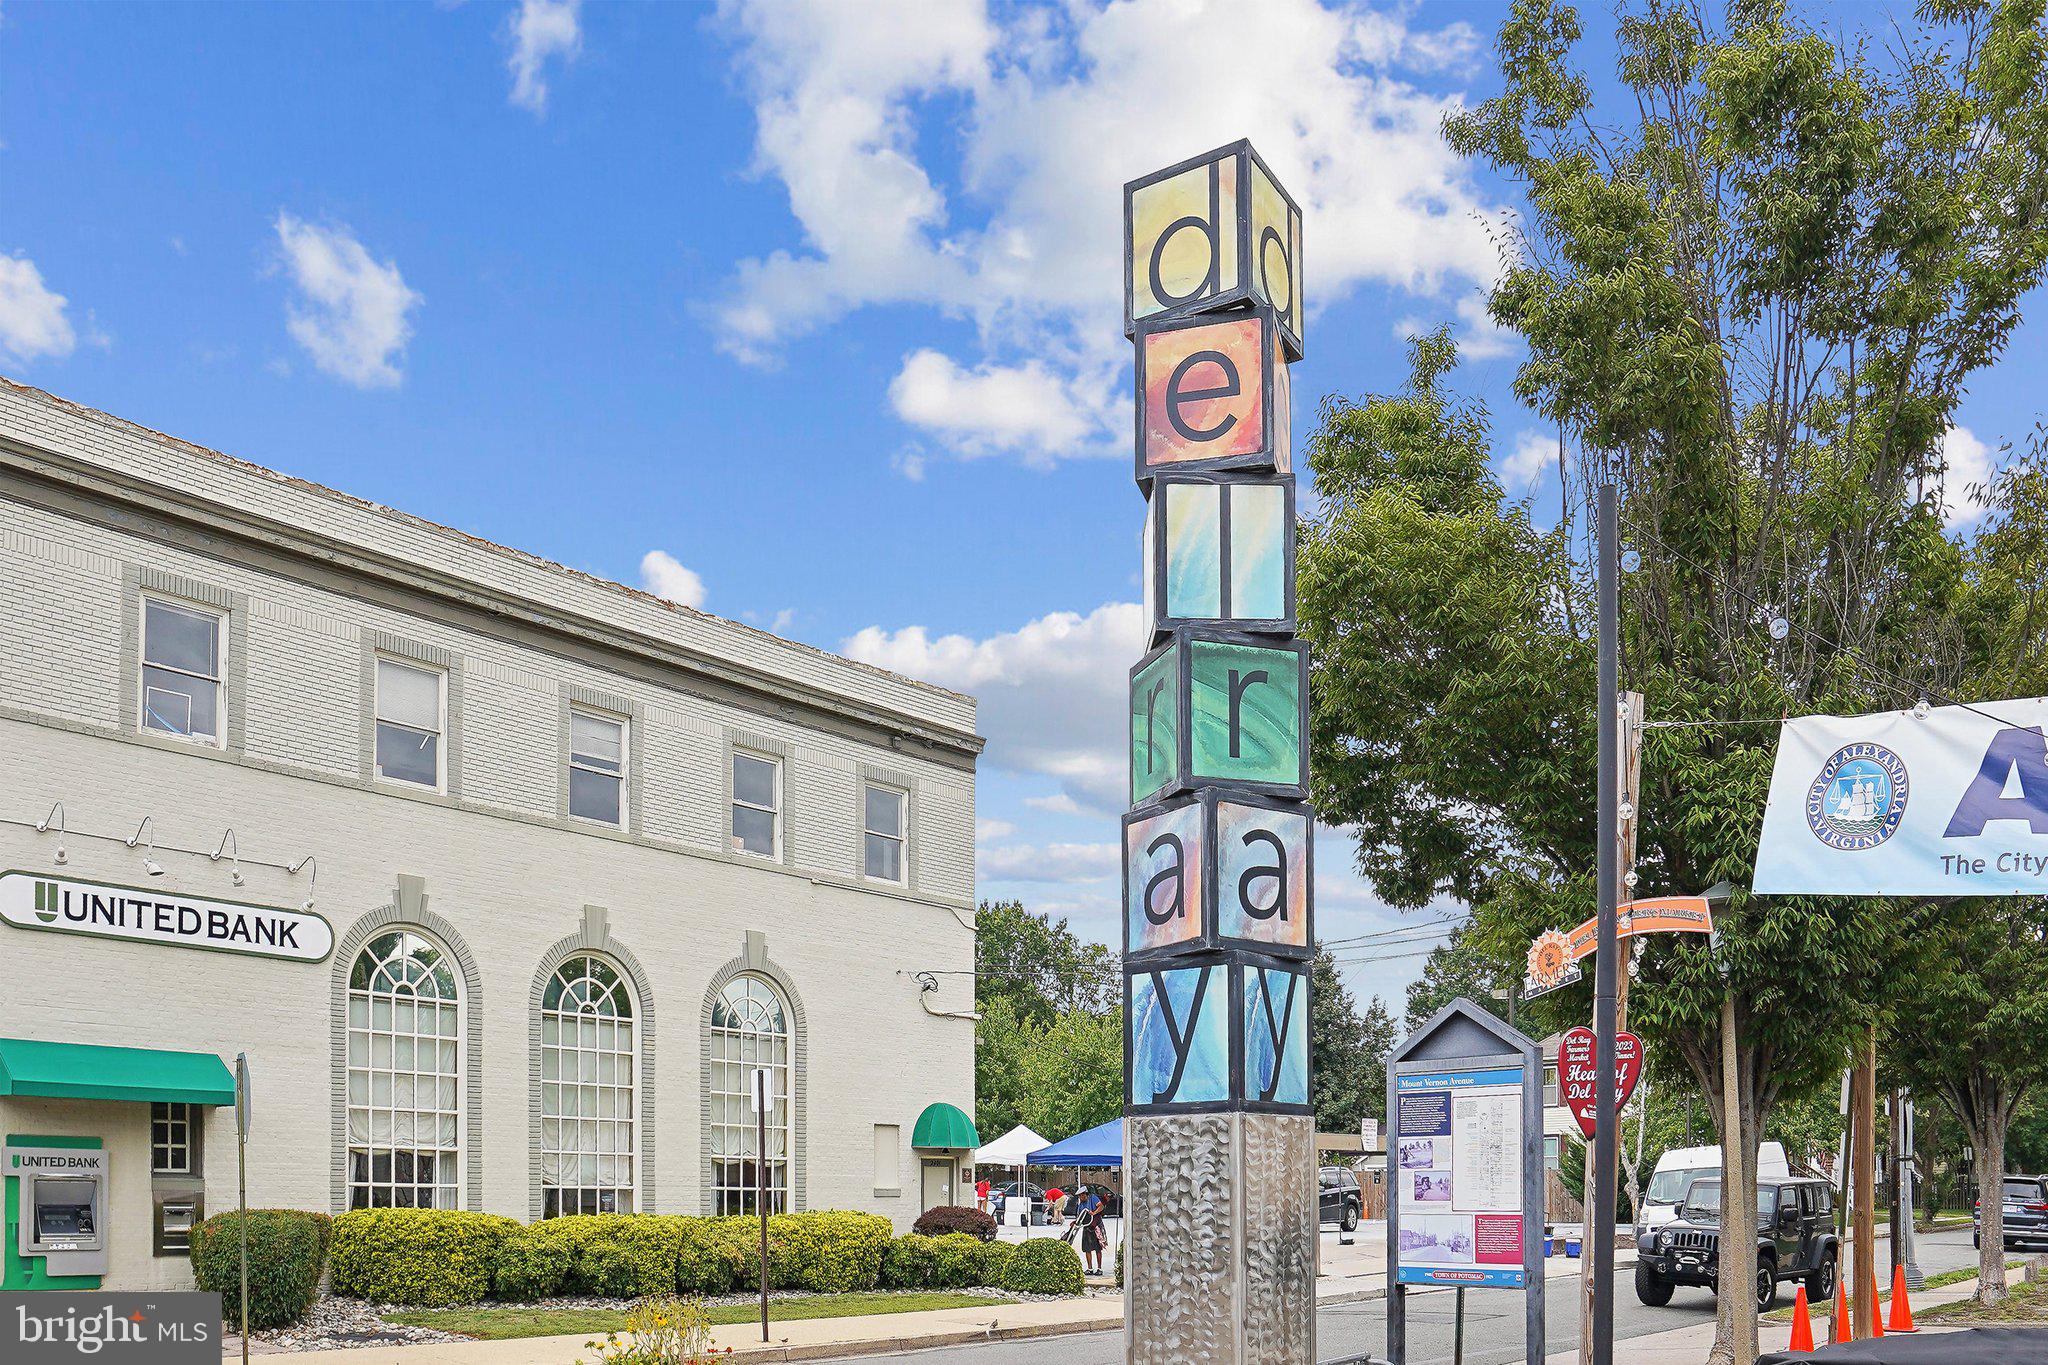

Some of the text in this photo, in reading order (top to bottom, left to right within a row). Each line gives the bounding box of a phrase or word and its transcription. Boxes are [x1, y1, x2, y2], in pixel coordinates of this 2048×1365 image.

[1808, 745, 1907, 815] CITY OF ALEXANDRIA
[1814, 820, 1895, 849] VIRGINIA
[1940, 852, 2048, 877] The City
[63, 890, 300, 949] UNITED BANK
[1615, 1041, 1634, 1051] 2023
[1566, 1064, 1598, 1081] Hea
[1401, 1077, 1475, 1088] Mount Vernon Avenue
[1568, 1083, 1592, 1099] Del
[22, 1156, 100, 1168] UNITED BANK
